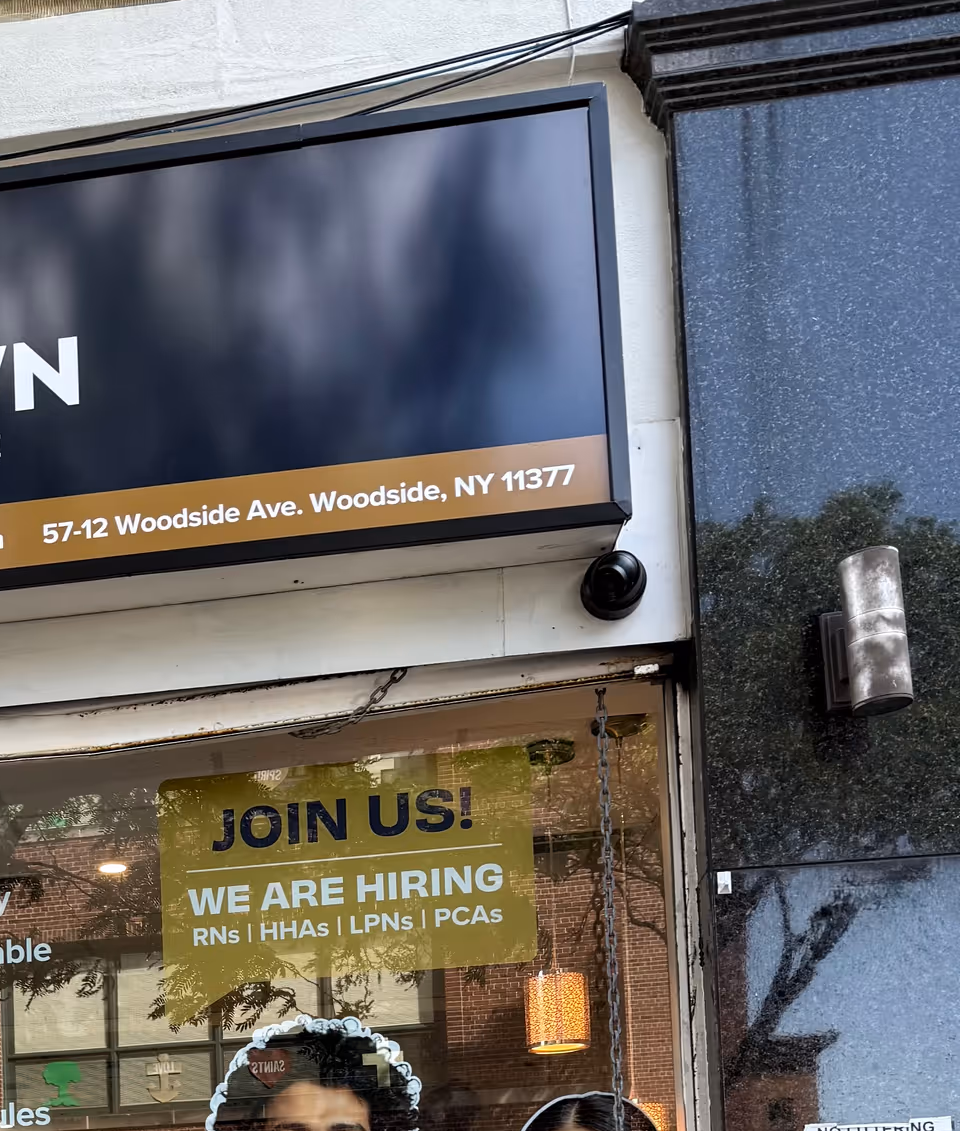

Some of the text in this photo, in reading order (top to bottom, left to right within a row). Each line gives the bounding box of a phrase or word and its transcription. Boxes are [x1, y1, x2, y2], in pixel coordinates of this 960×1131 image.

[42, 517, 109, 544] 57-12
[114, 501, 240, 536] Woodside
[246, 494, 303, 521] Ave.
[309, 481, 447, 514] Woodside,
[454, 472, 495, 497] NY
[501, 463, 576, 491] 11377
[211, 786, 474, 853] JOIN US!
[187, 862, 504, 917] WE ARE HIRING
[192, 925, 240, 947] RNs
[260, 918, 329, 943] HHAs
[349, 911, 413, 936] LPNs
[435, 904, 503, 928] PCAs
